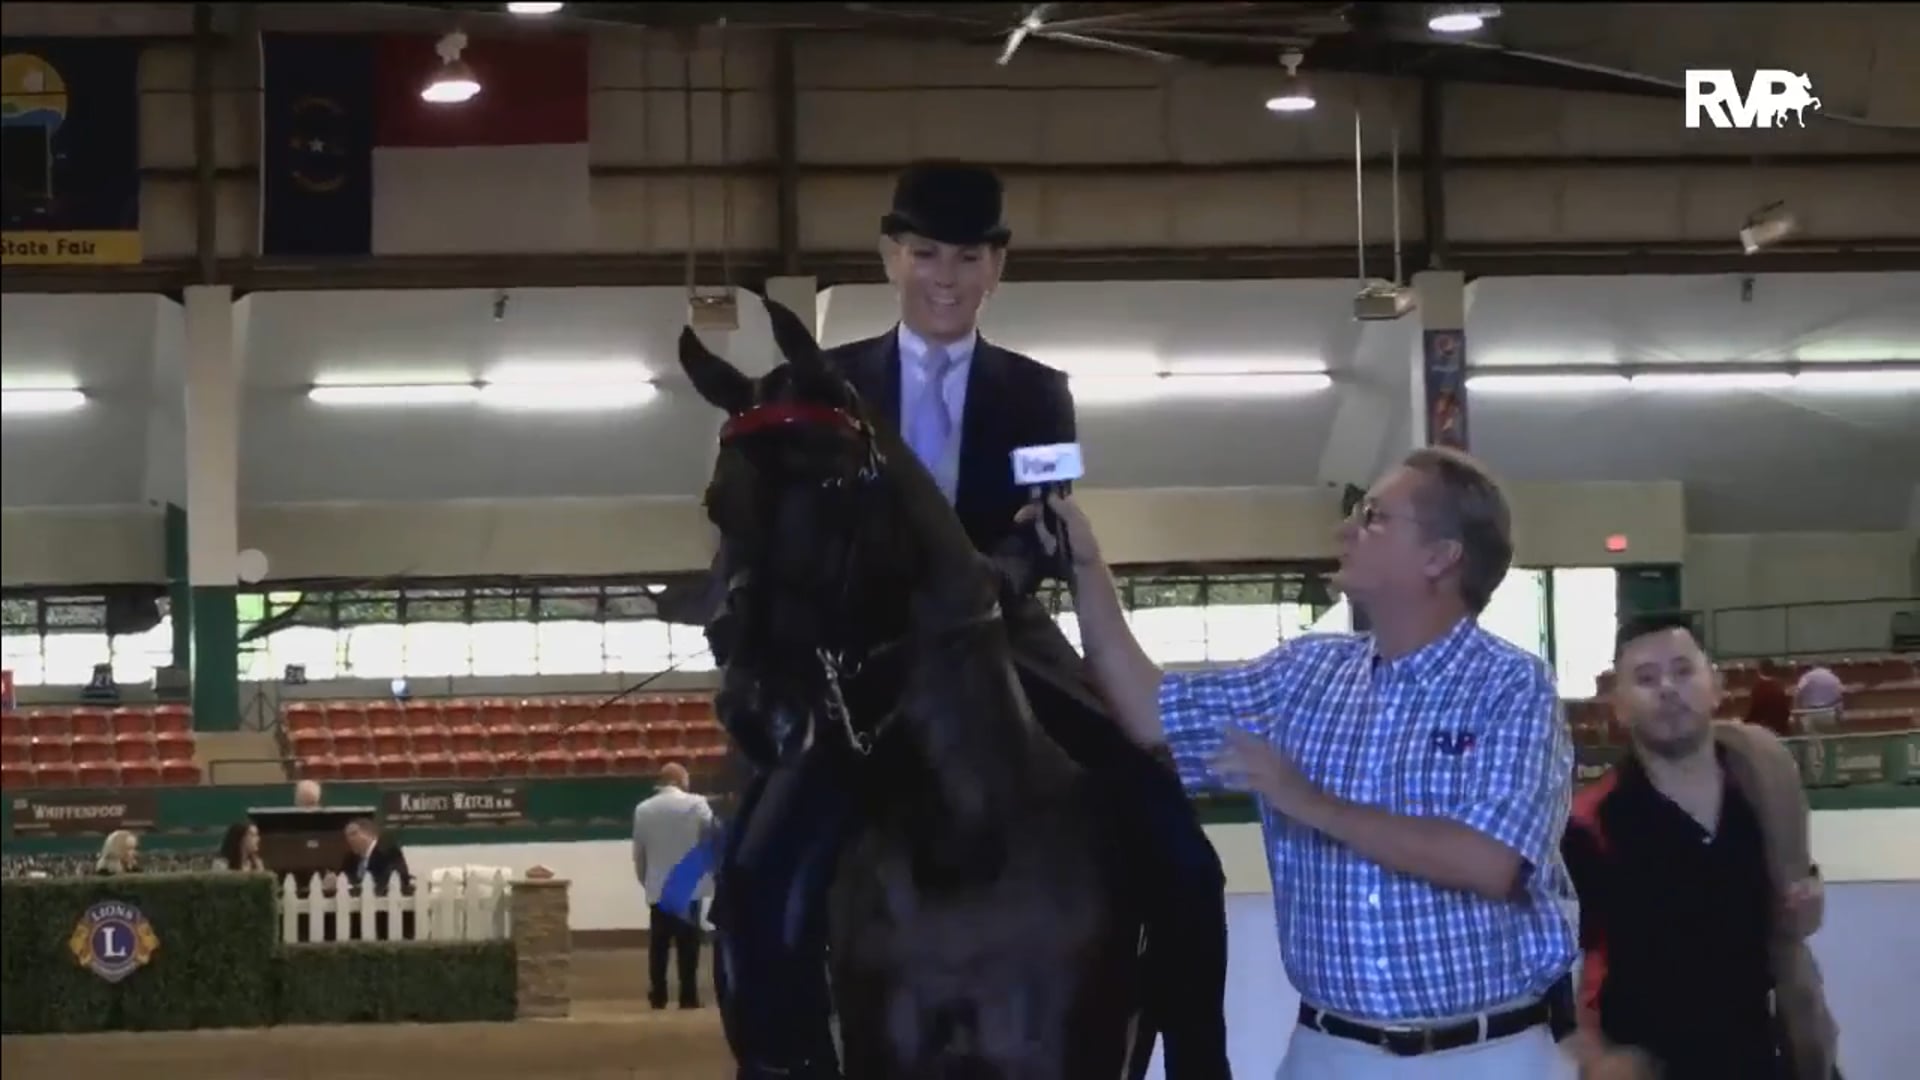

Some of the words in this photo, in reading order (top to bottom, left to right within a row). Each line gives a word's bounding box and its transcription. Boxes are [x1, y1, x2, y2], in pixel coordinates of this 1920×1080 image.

[1, 240, 48, 256] State
[57, 238, 96, 256] Fair
[453, 791, 494, 810] WATCH
[91, 904, 133, 921] LIONS
[102, 927, 126, 957] L
